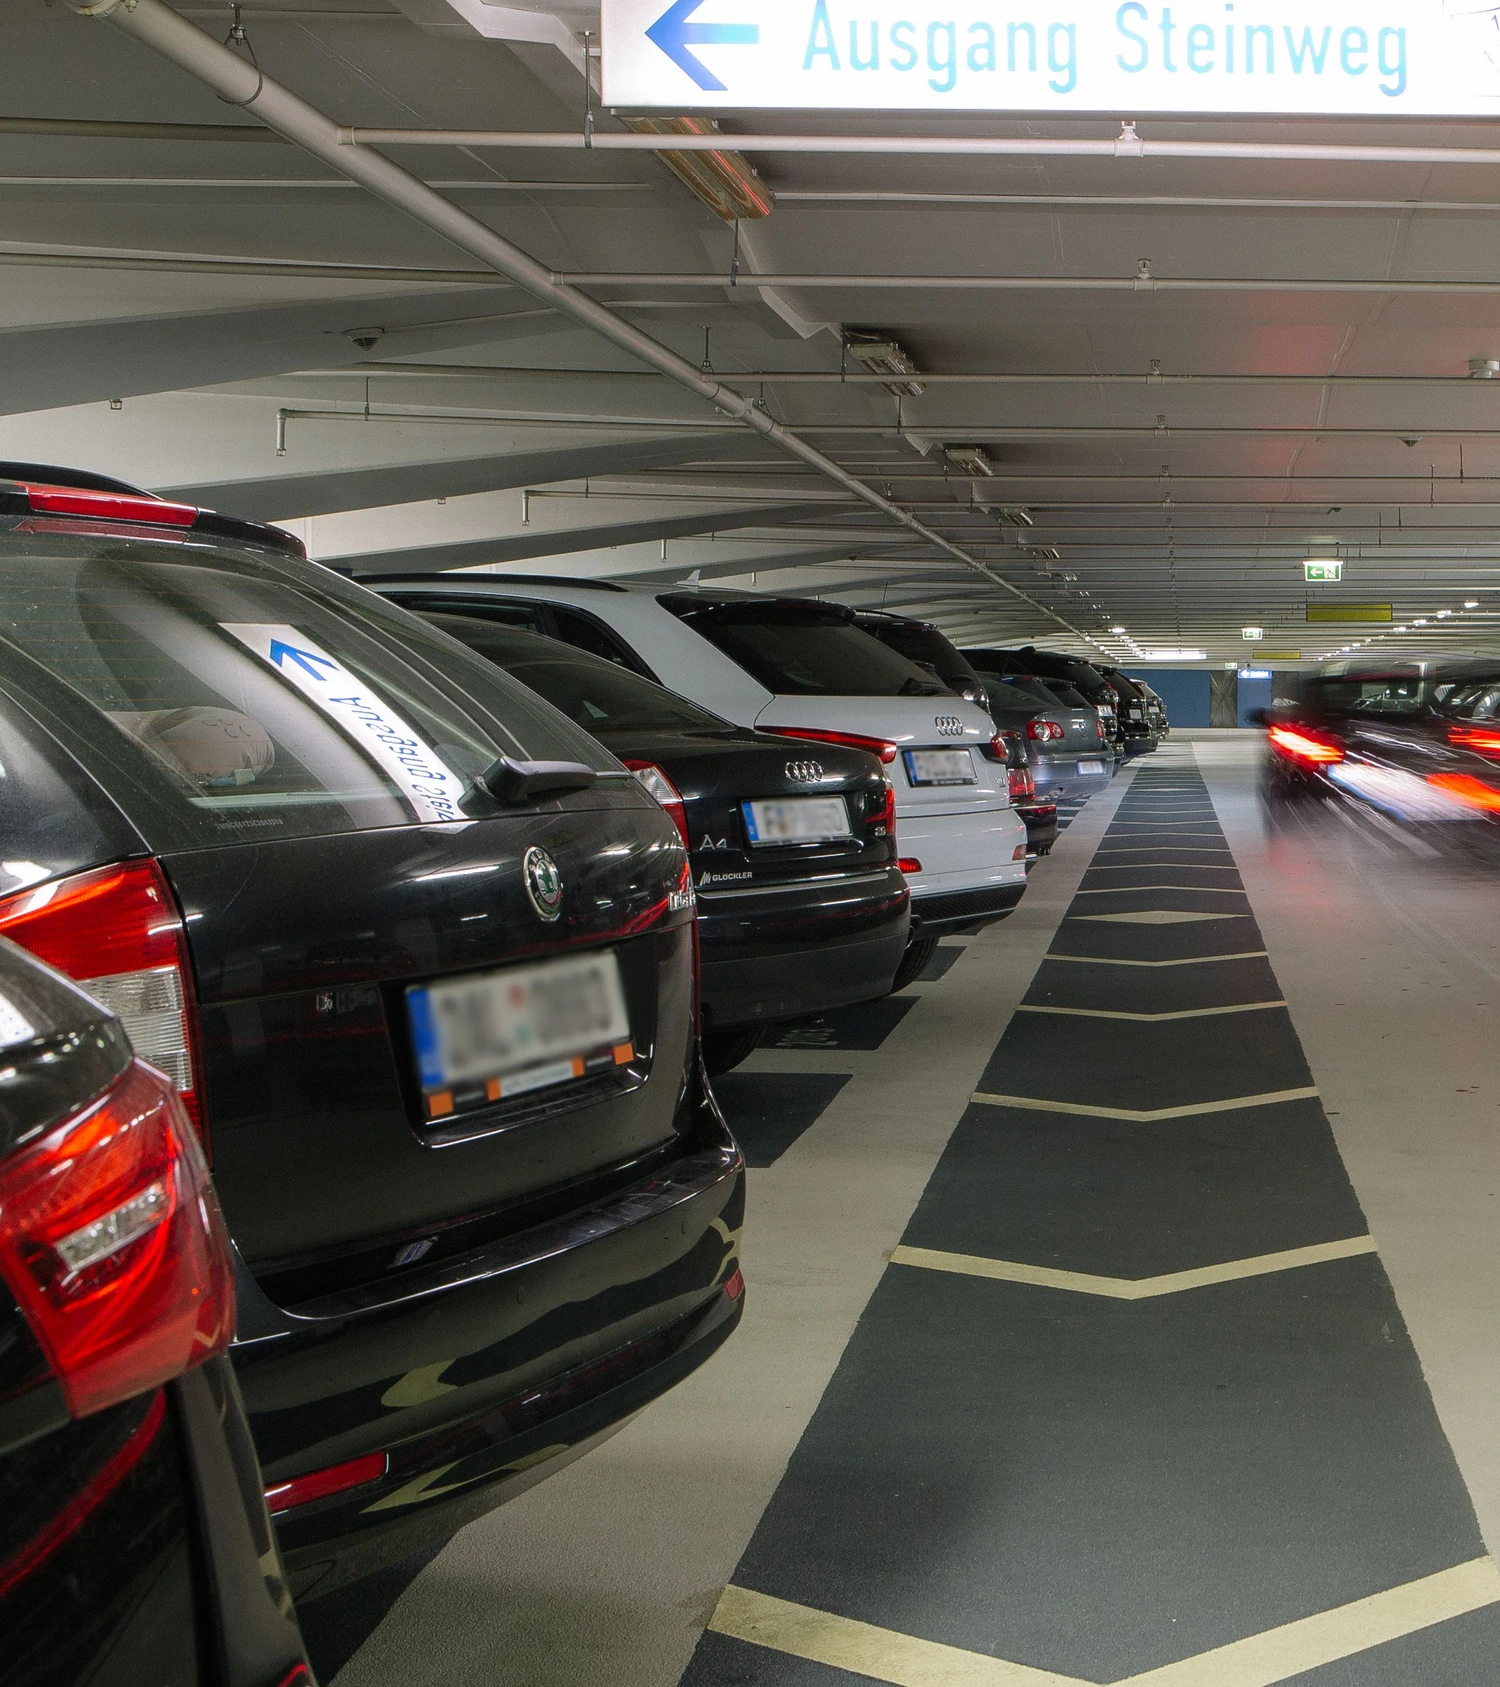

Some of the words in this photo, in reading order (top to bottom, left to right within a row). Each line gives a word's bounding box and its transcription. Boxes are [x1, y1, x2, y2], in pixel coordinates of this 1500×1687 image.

[802, 0, 1077, 94] Ausgang
[1115, 1, 1408, 98] Steinweg
[699, 834, 728, 851] A4
